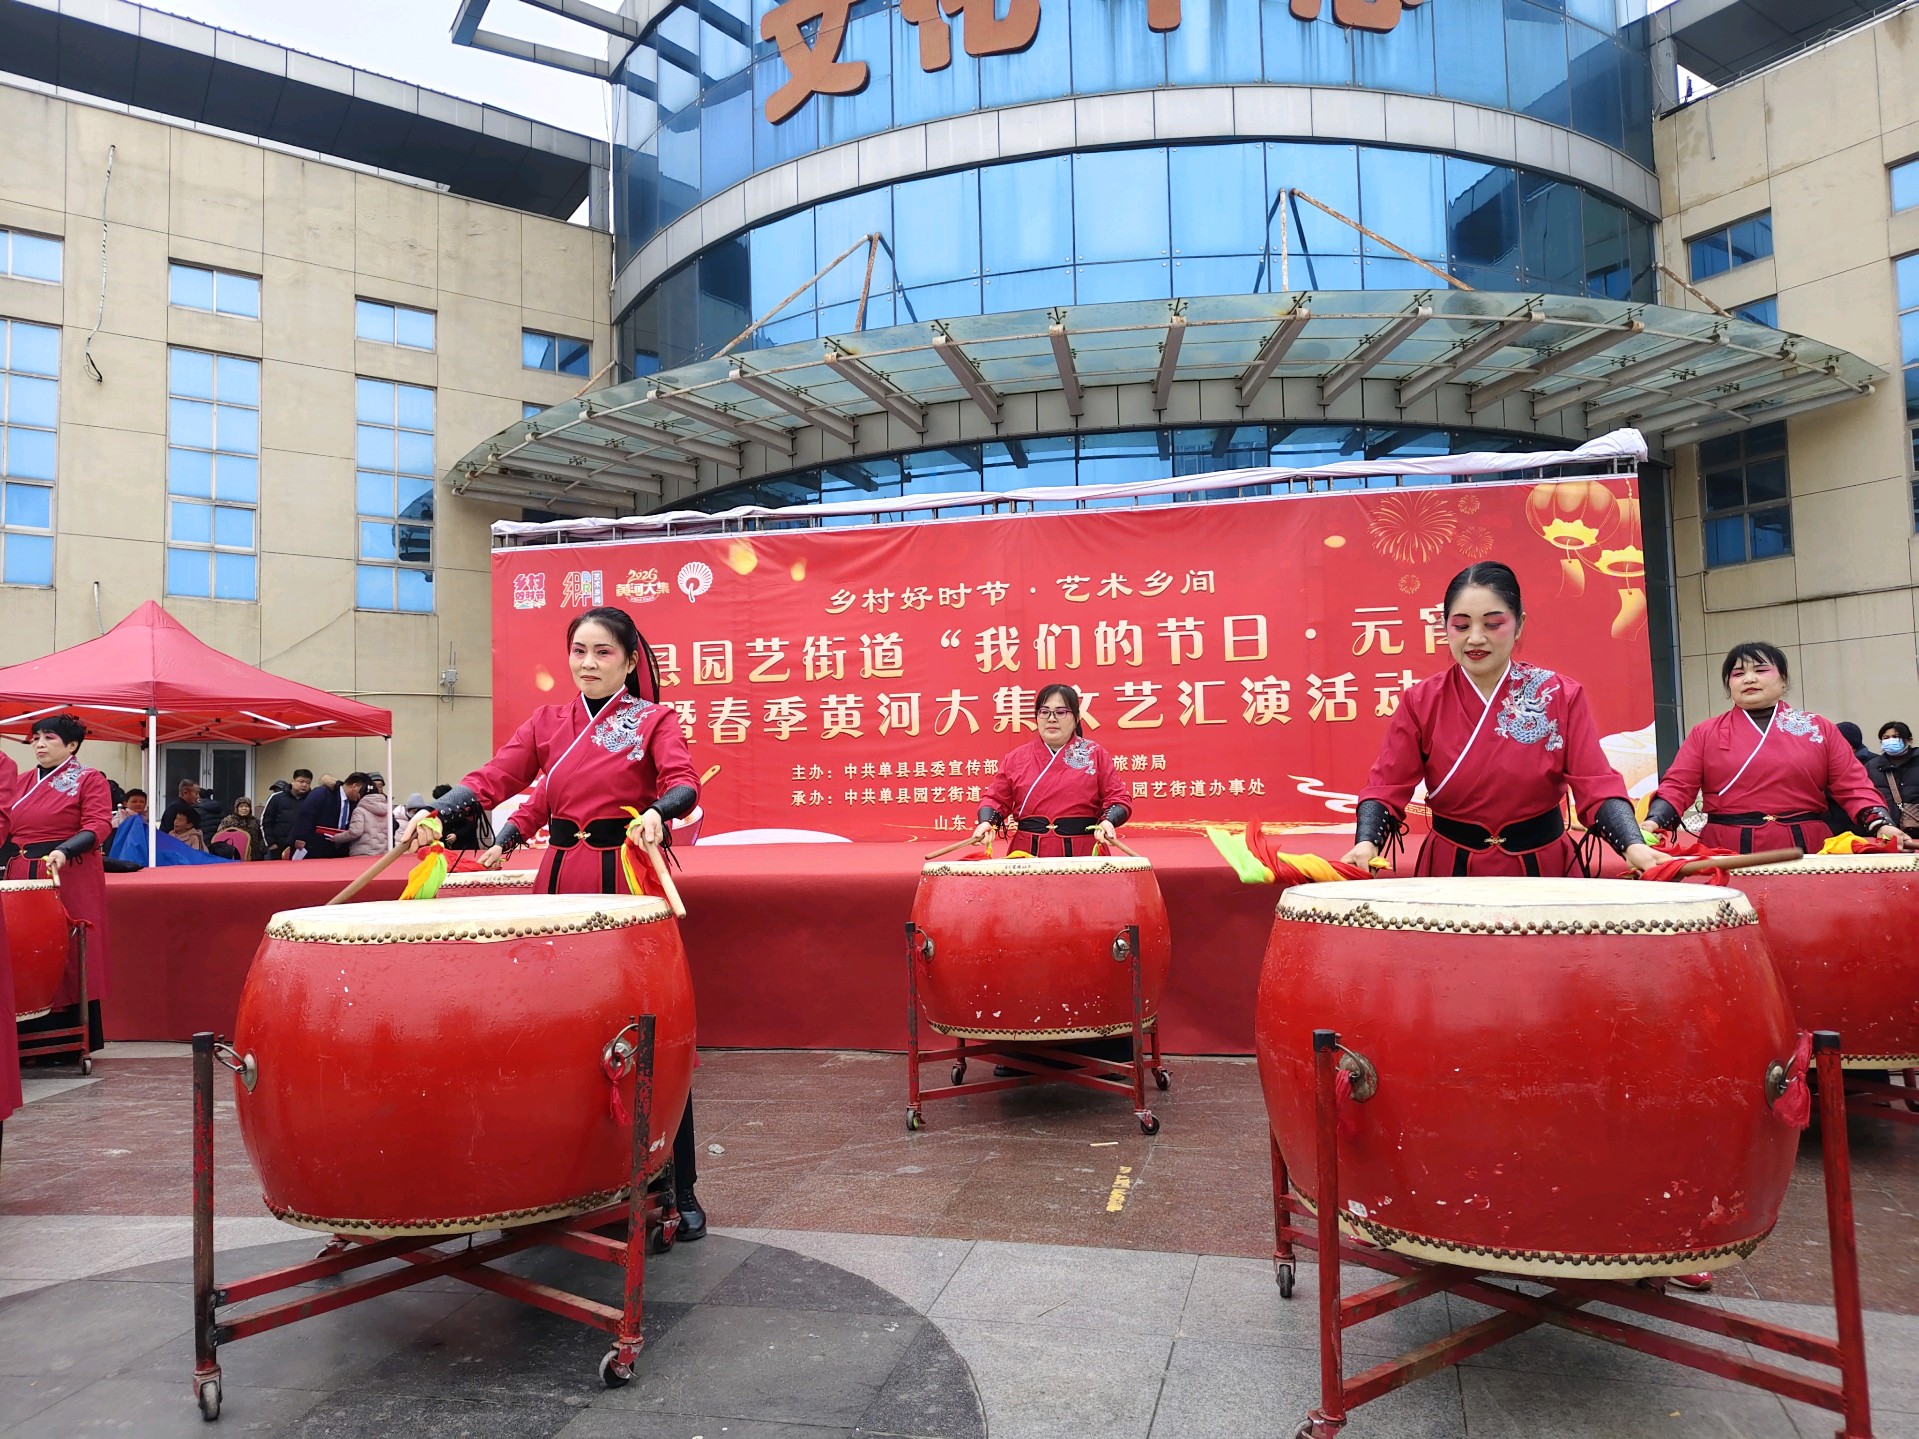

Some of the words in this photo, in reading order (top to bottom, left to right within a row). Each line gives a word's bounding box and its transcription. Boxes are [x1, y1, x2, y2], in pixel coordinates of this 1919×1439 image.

[627, 567, 658, 583] 2026
[615, 581, 670, 597] 黄河大集
[1112, 753, 1167, 772] 旅游局
